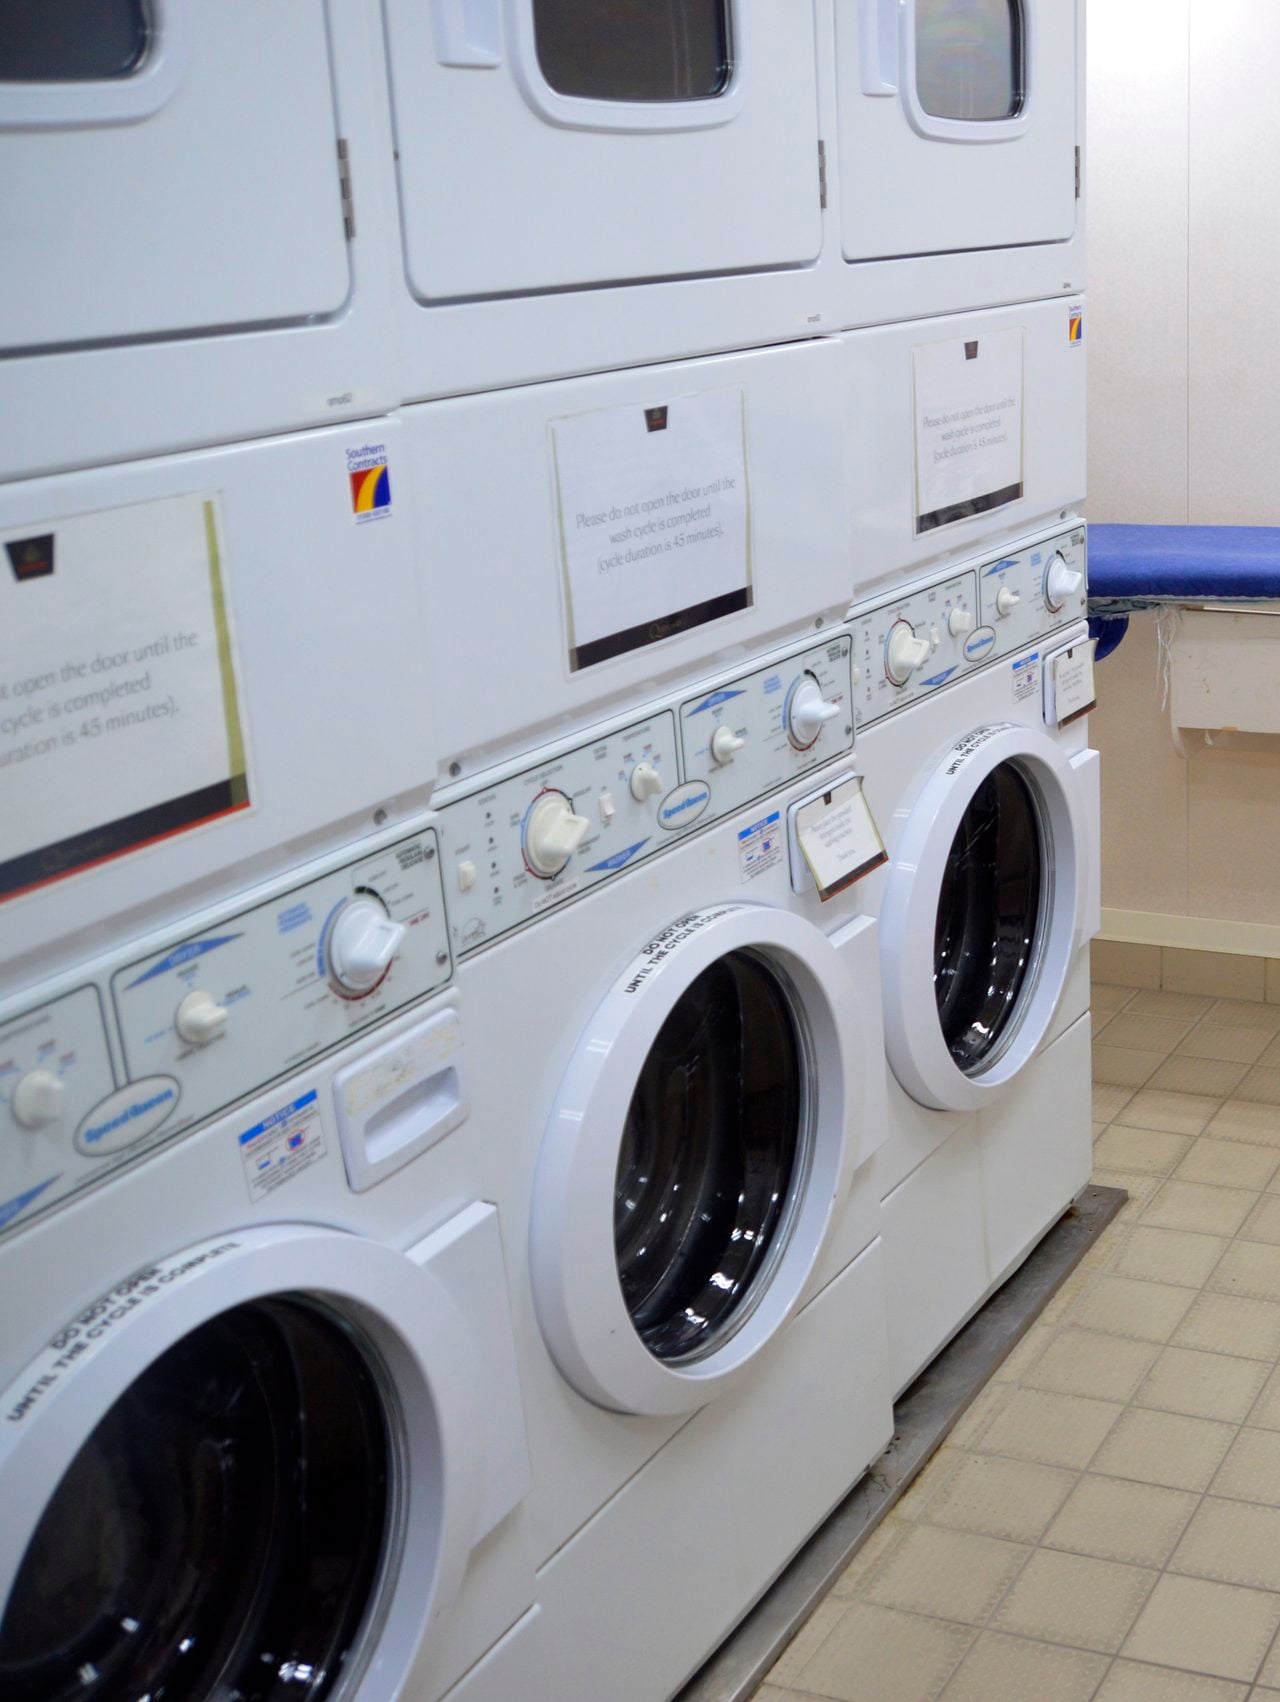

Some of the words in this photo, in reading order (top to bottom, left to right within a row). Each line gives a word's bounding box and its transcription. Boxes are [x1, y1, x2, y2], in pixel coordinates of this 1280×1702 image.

[923, 415, 941, 428] Please
[345, 444, 385, 460] Southern
[347, 455, 388, 471] Contracts
[576, 513, 607, 529] Please
[609, 505, 621, 521] do
[624, 502, 640, 518] not
[642, 497, 664, 516] open
[666, 490, 679, 505] the
[681, 485, 700, 501] door
[703, 480, 720, 496] until
[722, 477, 735, 491] the
[609, 526, 632, 544] wash
[634, 522, 656, 540] cycle
[658, 519, 666, 531] is
[667, 503, 711, 528] completed
[597, 555, 624, 575] (cycle
[625, 541, 662, 563] duration
[664, 538, 672, 551] is
[673, 532, 685, 548] 45
[12, 671, 56, 698] open
[60, 660, 87, 683] the
[90, 652, 129, 674] door
[133, 635, 170, 662] until
[173, 631, 198, 650] the
[1, 704, 43, 737] cycle
[48, 702, 61, 718] is
[63, 671, 151, 713] completed
[62, 727, 75, 746] is
[79, 717, 101, 738] 45
[105, 695, 180, 733] minutes).
[945, 758, 965, 775] UNTIL
[960, 747, 975, 757] THE
[955, 743, 967, 752] DO
[662, 800, 686, 820] Speed
[685, 791, 708, 809] Queen
[642, 943, 660, 955] DO
[659, 928, 679, 943] NOT
[675, 914, 703, 928] OPEN
[624, 967, 653, 994] UNTIL
[647, 950, 669, 965] THE
[664, 928, 696, 950] CYCLE
[84, 1110, 131, 1144] Speed
[129, 1088, 174, 1118] Queen
[263, 1103, 295, 1130] NOTICE
[52, 1327, 80, 1350] DO
[79, 1298, 117, 1326] NOT
[115, 1267, 163, 1297] OPEN
[7, 1374, 58, 1423] UNTIL
[52, 1341, 89, 1369] THE
[86, 1297, 142, 1340] CYCLE
[139, 1284, 160, 1297] IS
[157, 1241, 242, 1284] COMPLETE
